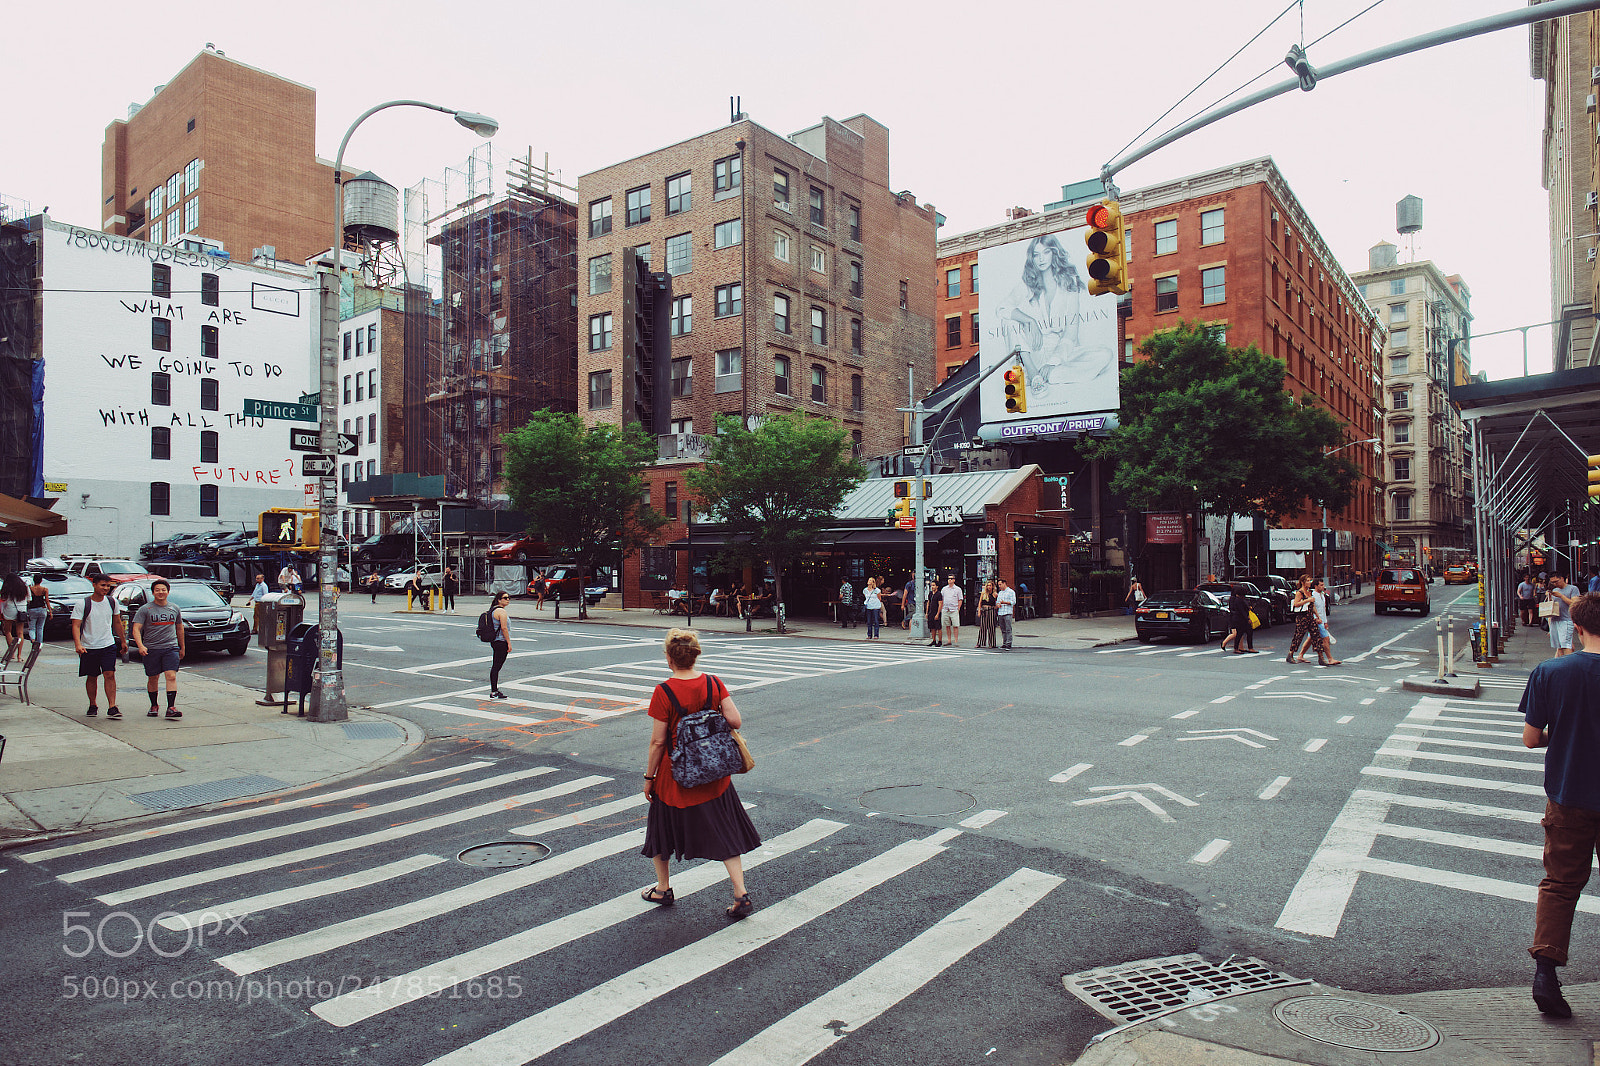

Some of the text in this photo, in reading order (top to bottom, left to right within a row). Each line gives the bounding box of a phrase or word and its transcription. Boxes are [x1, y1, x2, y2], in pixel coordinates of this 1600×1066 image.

[120, 300, 246, 325] WHAT ARE
[101, 354, 142, 369] WE
[228, 361, 253, 377] TO
[264, 362, 282, 378] DO
[254, 402, 310, 418] Prince St
[171, 413, 213, 427] ALL
[300, 436, 349, 449] ONE AY
[193, 459, 297, 487] FUTURE?
[305, 461, 331, 470] ONE WAY
[305, 485, 314, 493] NO
[923, 505, 963, 524] Park
[151, 613, 175, 623] USA
